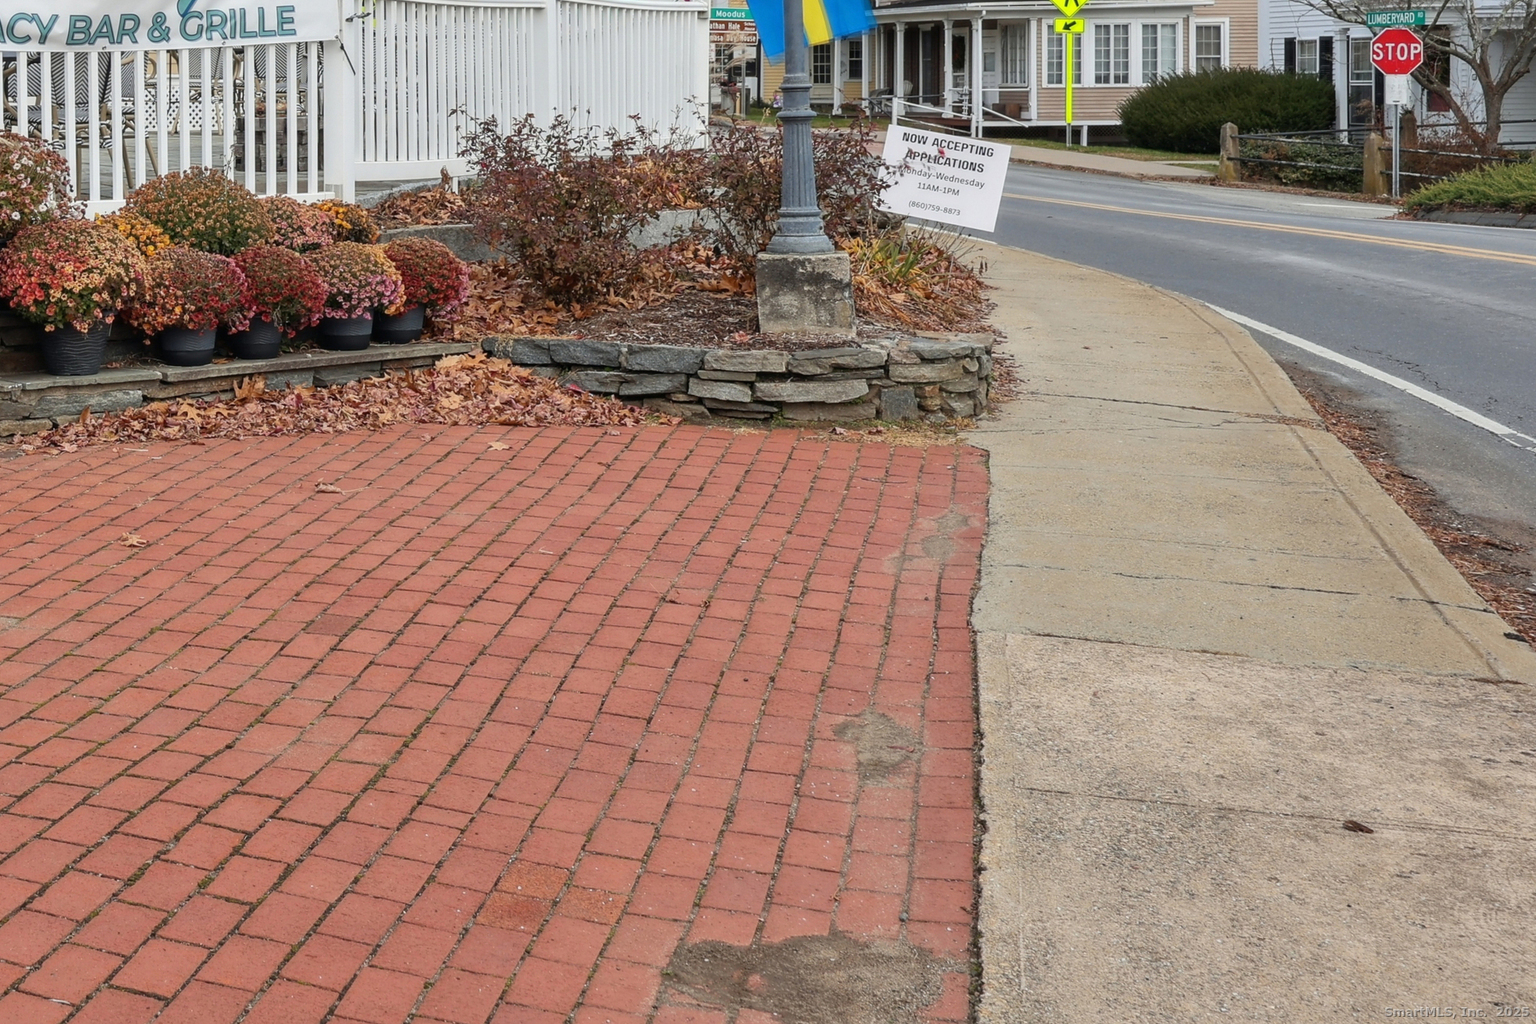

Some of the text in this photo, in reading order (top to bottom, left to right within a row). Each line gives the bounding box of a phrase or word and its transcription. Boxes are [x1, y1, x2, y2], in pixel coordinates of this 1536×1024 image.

[716, 10, 746, 18] Moodus
[1368, 12, 1415, 24] LUMBERYARD
[65, 14, 141, 46] BAR
[146, 11, 170, 43] &
[179, 5, 297, 42] GRILLE
[710, 22, 725, 30] athan
[1373, 42, 1421, 61] STOP
[902, 132, 995, 158] NOW ACCEPTING
[904, 149, 985, 173] APPLICATIONS
[898, 167, 986, 189] Monday-Wednesday
[917, 182, 960, 197] 11AM-1PM
[908, 200, 961, 216] (860)759-8873
